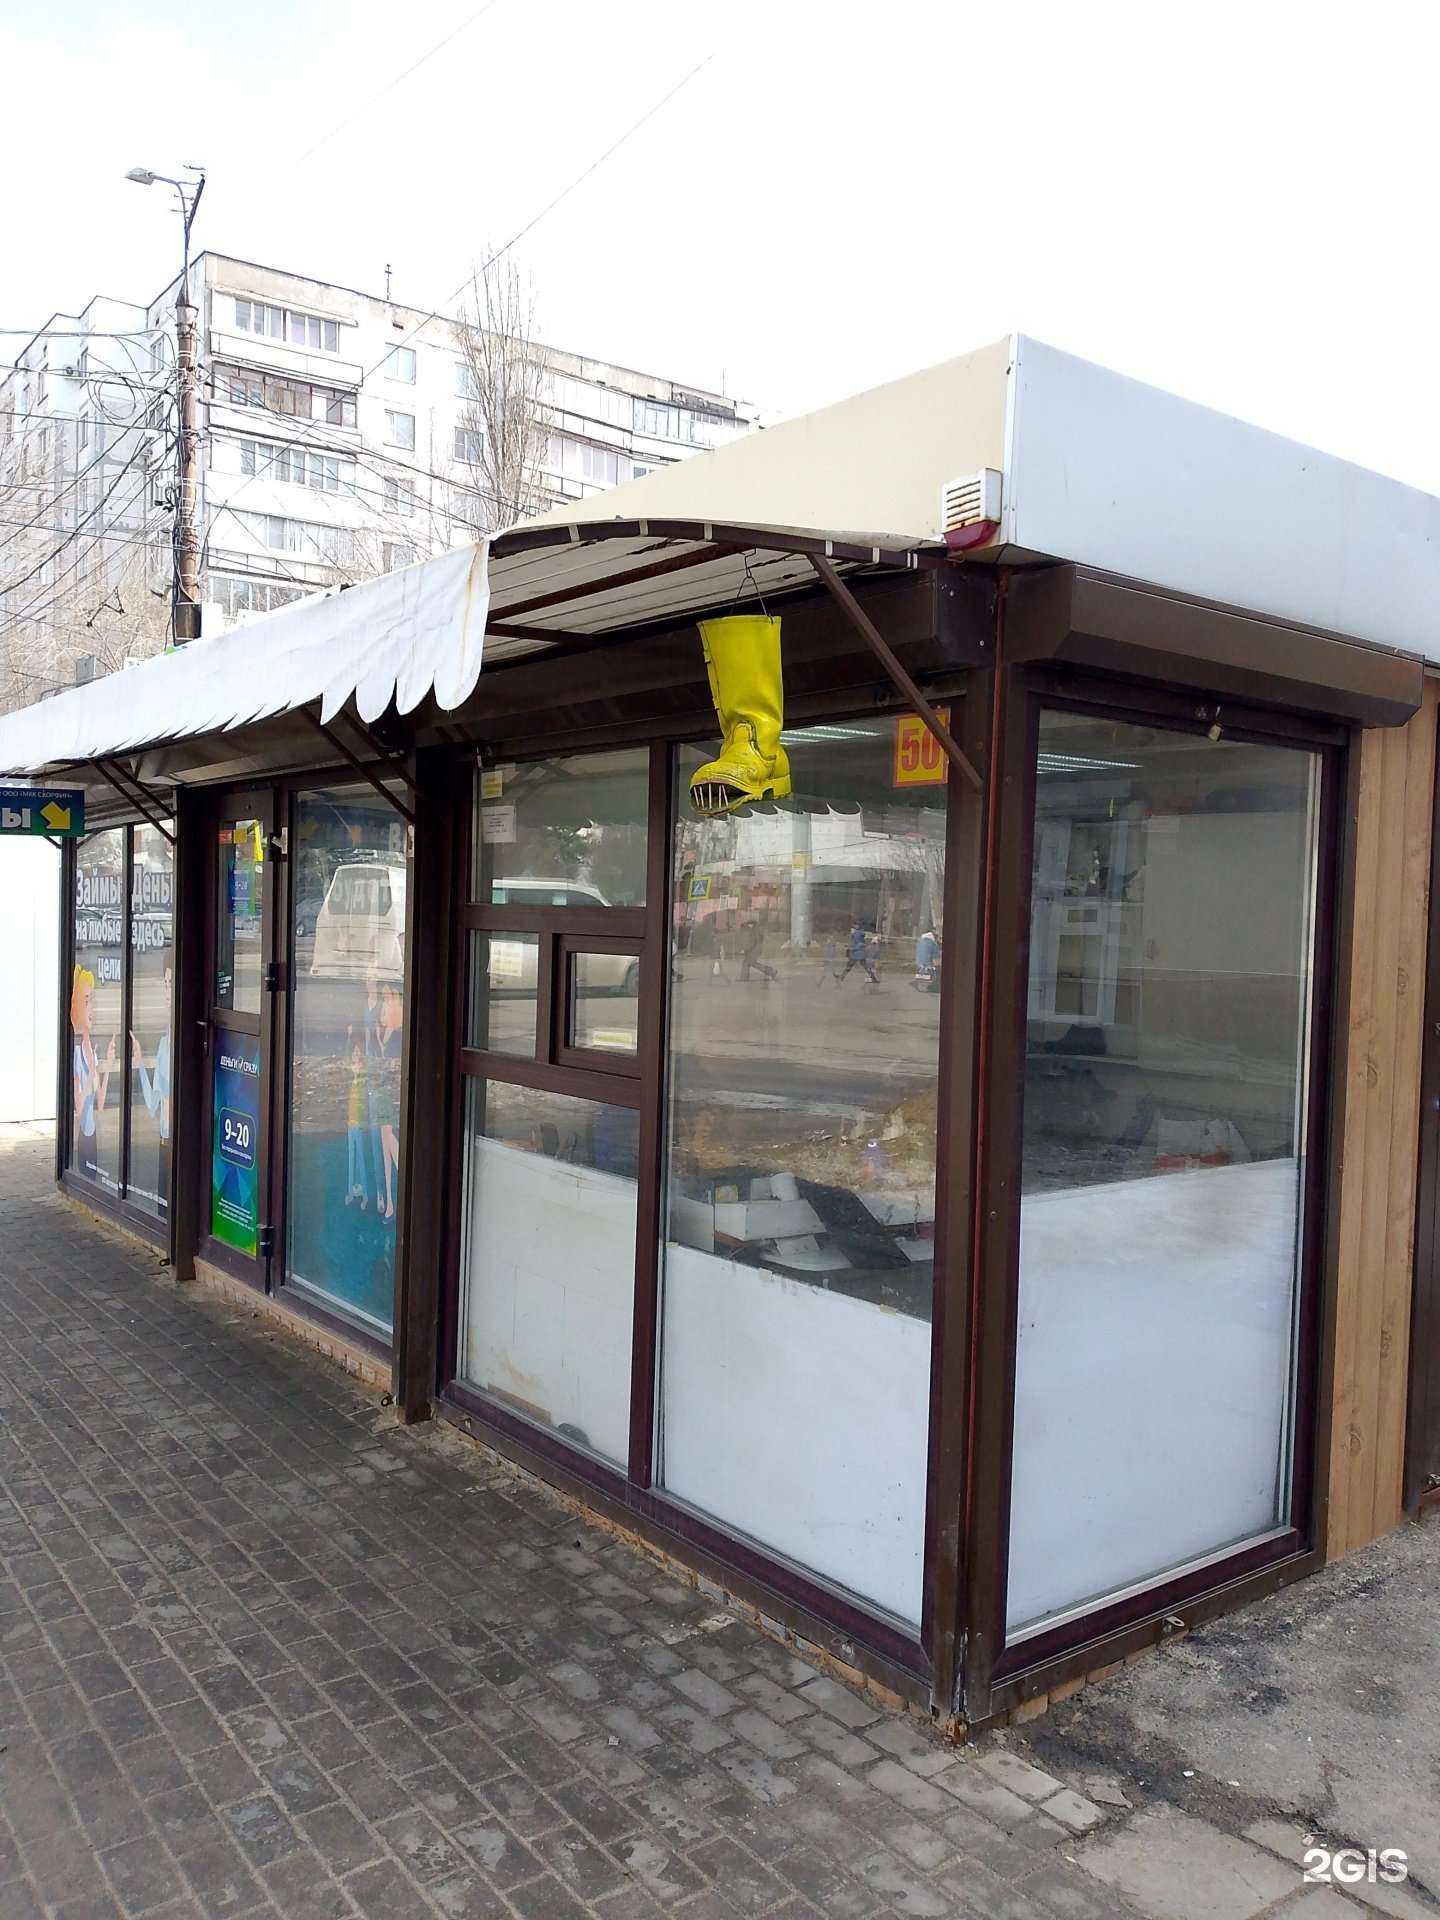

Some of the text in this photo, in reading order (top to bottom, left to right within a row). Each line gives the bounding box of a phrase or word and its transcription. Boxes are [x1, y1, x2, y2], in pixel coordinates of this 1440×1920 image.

[902, 728, 940, 770] 50
[76, 867, 121, 906] Займы
[76, 912, 121, 943] на любые
[131, 921, 165, 951] здесь
[97, 957, 121, 985] цели
